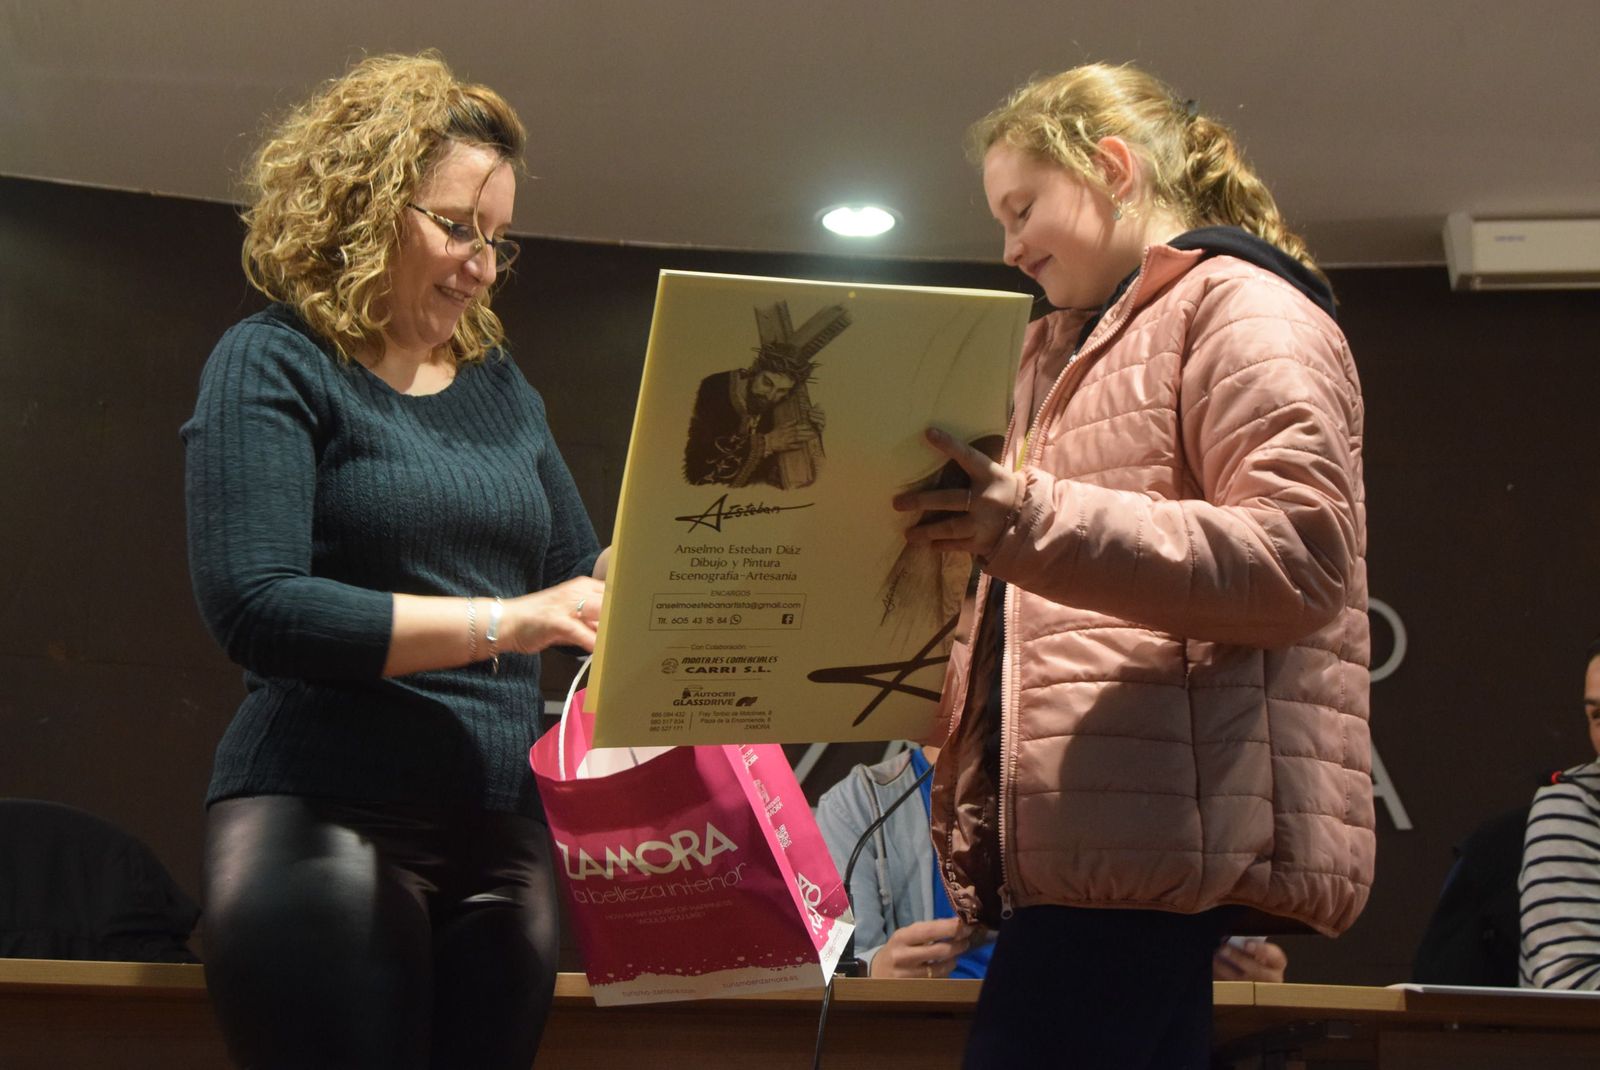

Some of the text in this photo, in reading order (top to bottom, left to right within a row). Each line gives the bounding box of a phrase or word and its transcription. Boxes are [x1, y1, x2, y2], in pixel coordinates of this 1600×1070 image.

[674, 544, 725, 555] Anselmo
[728, 544, 772, 555] Esteban
[690, 557, 781, 570] Dibujo y Pintura
[656, 601, 801, 610] anselmoestebanartista@gmail.com
[671, 617, 689, 625] 605
[691, 643, 704, 651] Con
[682, 655, 779, 664] MONTAJES COMERCIALES
[685, 666, 771, 674] CARRI S.L.
[673, 699, 734, 707] GLASSDRIVE
